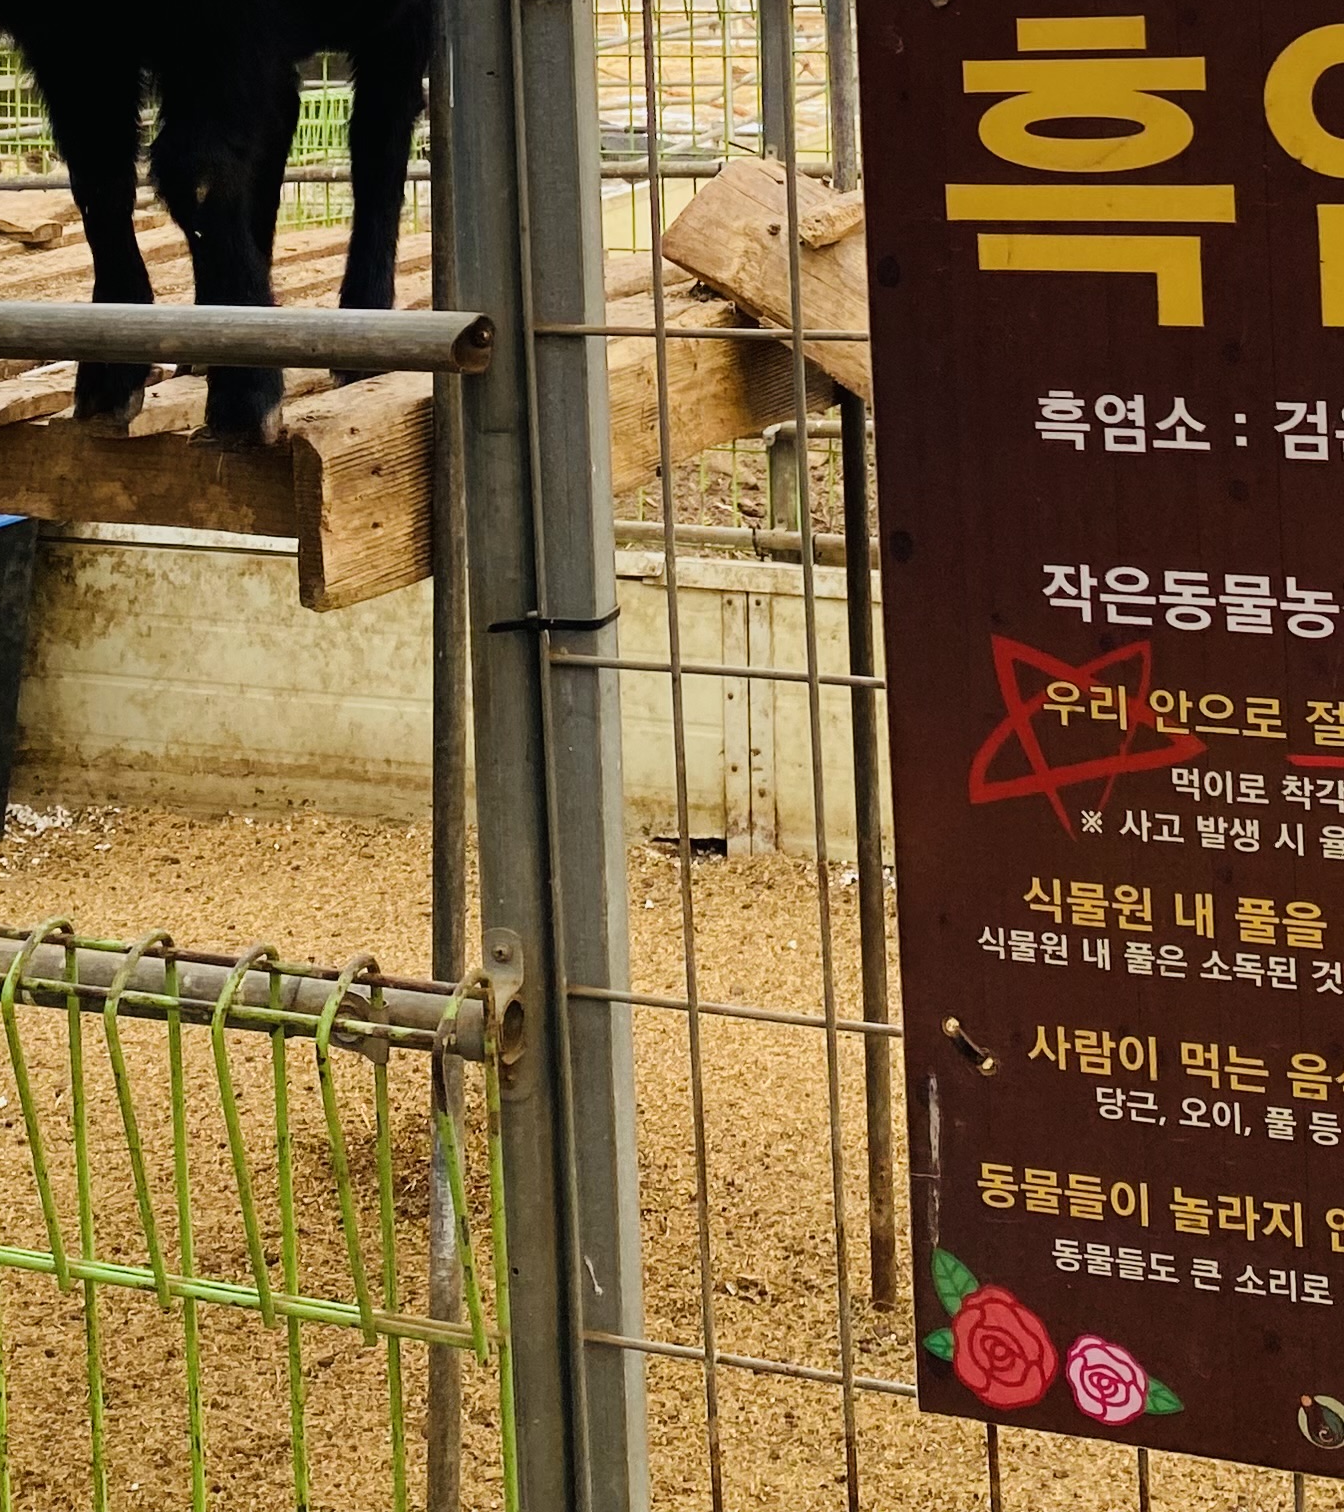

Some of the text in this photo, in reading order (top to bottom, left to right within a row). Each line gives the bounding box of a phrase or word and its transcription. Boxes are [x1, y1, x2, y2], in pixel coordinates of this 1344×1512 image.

[1034, 390, 1211, 453] 흑염소
[1043, 681, 1128, 731] 우리
[1149, 689, 1287, 739] 안으로
[1171, 767, 1270, 805] 먹이로
[1118, 809, 1185, 843] 사고
[1196, 815, 1260, 853] 발생
[1274, 823, 1305, 857] 시
[1023, 876, 1153, 932] 식물원
[1174, 893, 1215, 939] 내
[1234, 896, 1328, 950] 풀을
[977, 926, 1069, 966] 식물원
[1082, 938, 1111, 971] 내
[1123, 941, 1188, 979] 풀은
[1199, 950, 1298, 990] 소독된
[1027, 1025, 1158, 1081] 사람이
[1180, 1041, 1270, 1094] 먹는
[1095, 1086, 1167, 1127] 당근,
[1178, 1097, 1252, 1137] 오이,
[1264, 1106, 1297, 1141] 풀
[1308, 1111, 1342, 1146] 등
[976, 1162, 1149, 1228] 동물들이
[1169, 1186, 1304, 1248] 놀라지
[1051, 1238, 1180, 1284] 동물들도
[1190, 1258, 1222, 1292] 큰
[1234, 1264, 1334, 1305] 소리로
